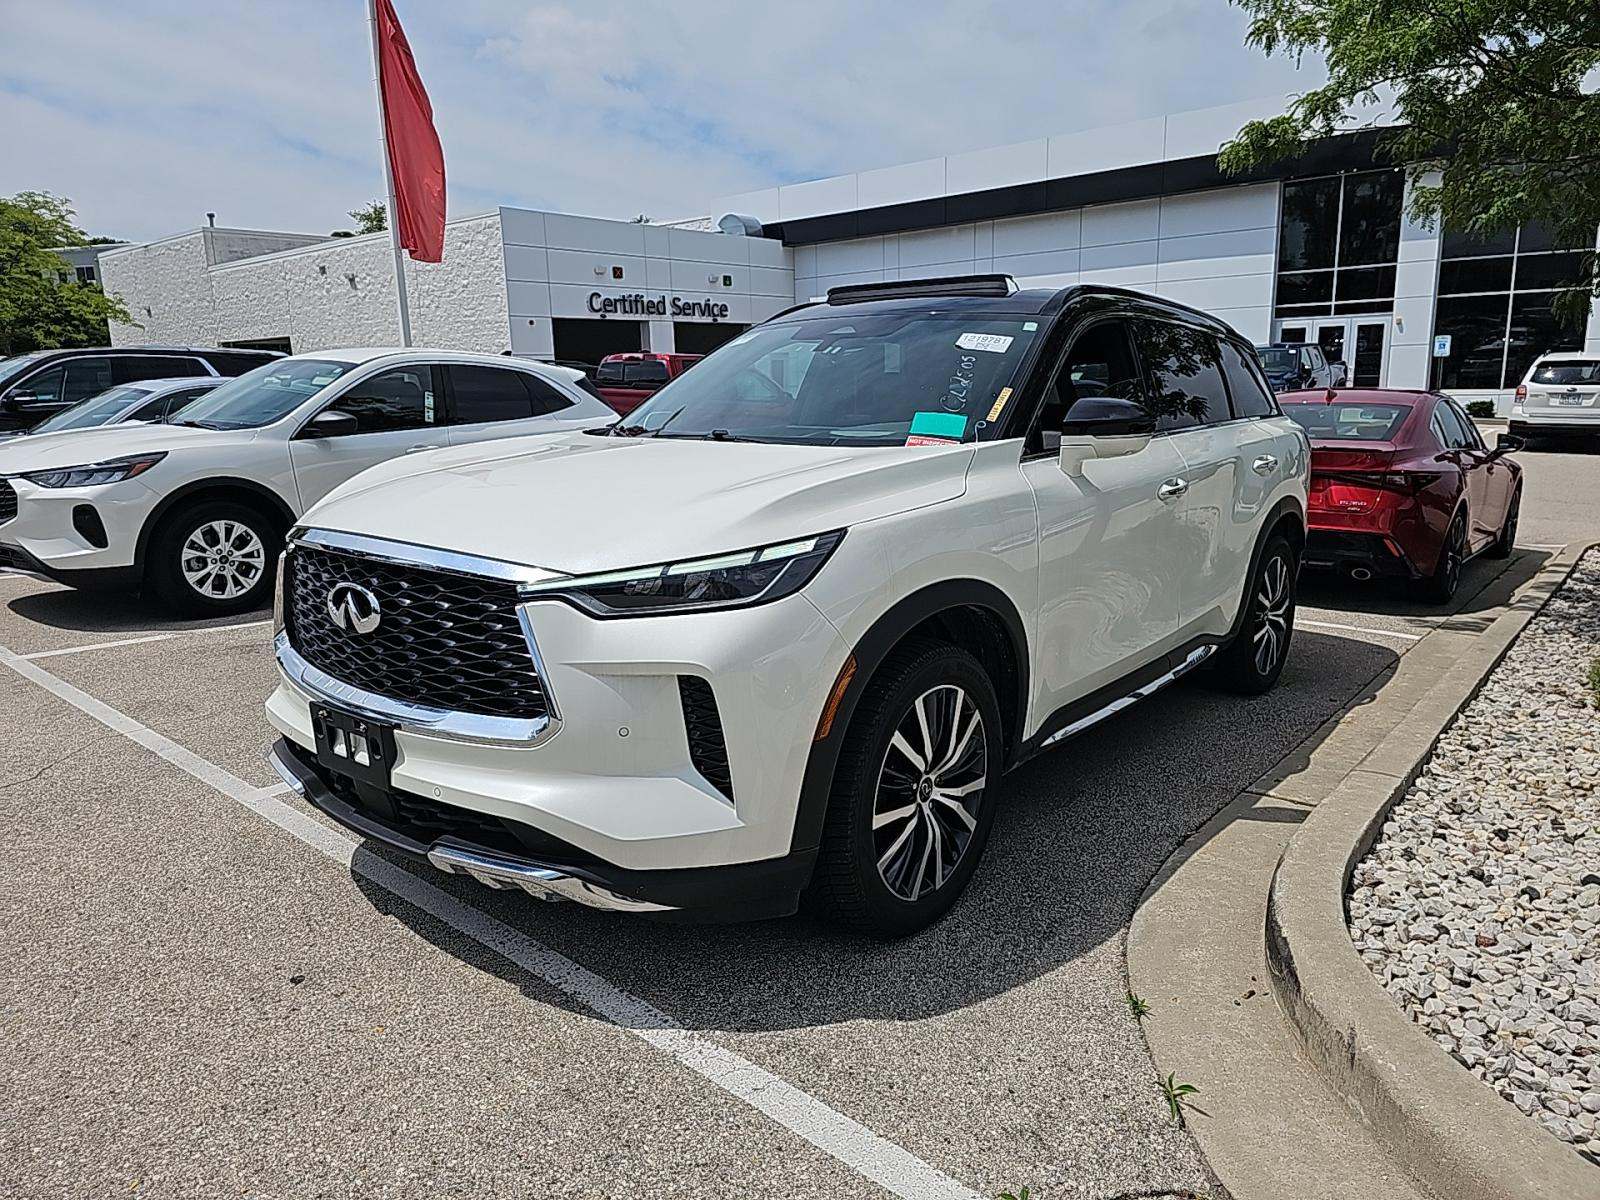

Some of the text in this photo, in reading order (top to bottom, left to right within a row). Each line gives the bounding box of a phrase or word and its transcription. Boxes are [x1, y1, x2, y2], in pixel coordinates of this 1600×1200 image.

[589, 291, 729, 318] Certified Service
[962, 334, 1009, 345] 1219781
